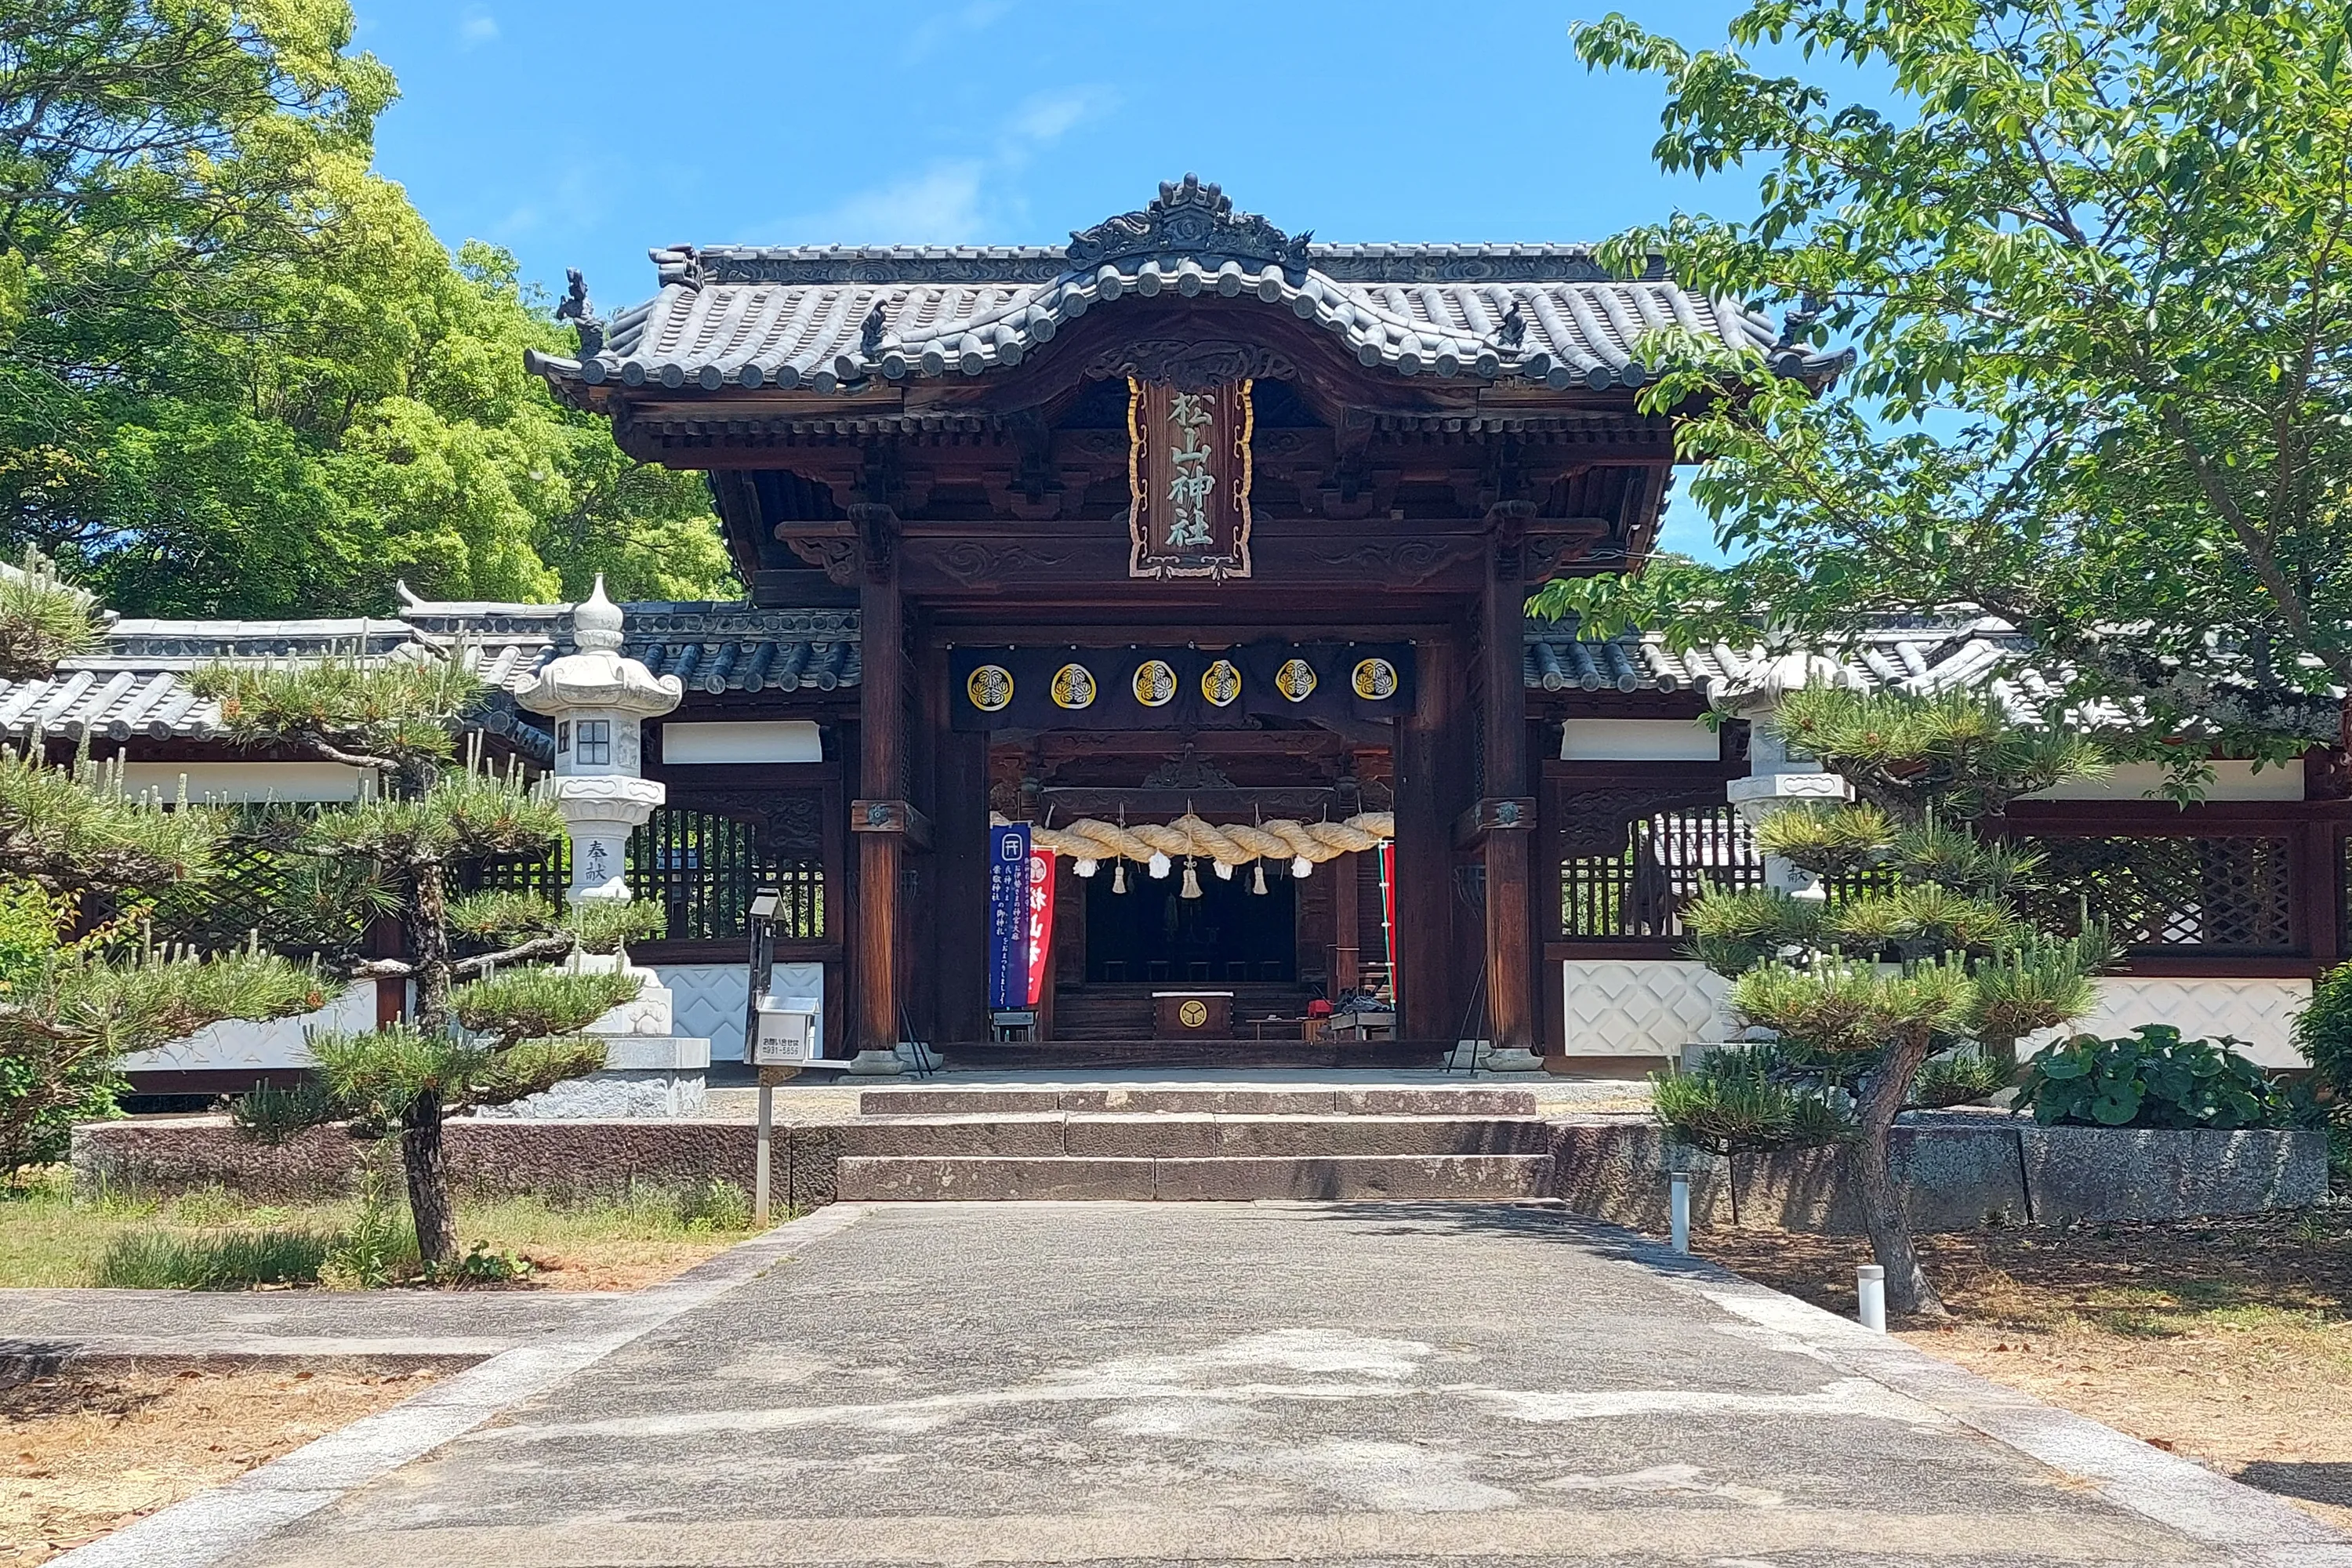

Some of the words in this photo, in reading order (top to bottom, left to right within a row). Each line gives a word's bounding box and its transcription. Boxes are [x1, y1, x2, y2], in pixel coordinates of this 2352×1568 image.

[1165, 391, 1216, 546] 松山神社
[586, 840, 608, 881] 奉献
[1004, 865, 1012, 901] 氏神さま
